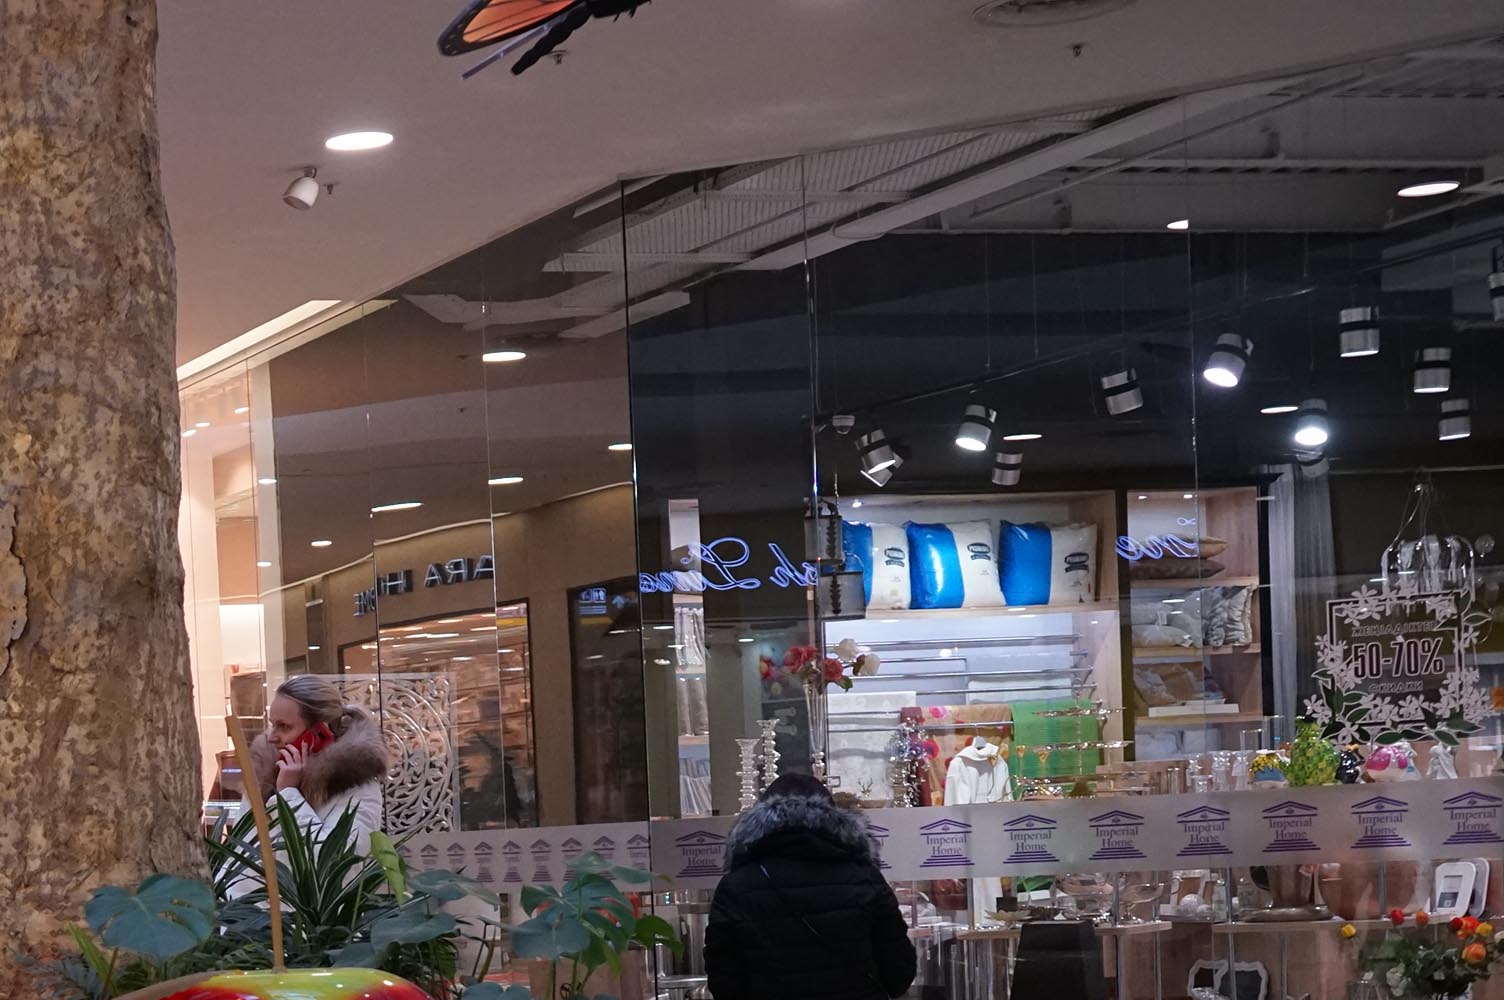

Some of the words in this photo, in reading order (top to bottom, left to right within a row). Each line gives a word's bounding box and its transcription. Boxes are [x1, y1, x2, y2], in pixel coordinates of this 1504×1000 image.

[1351, 637, 1446, 680] 50-70%
[1358, 814, 1403, 827] Imperial
[1449, 809, 1497, 823] Imperial
[1269, 818, 1313, 830] Imperial
[1457, 820, 1490, 832] Home
[1010, 830, 1052, 843] Imperial
[1096, 826, 1139, 839] Imperial
[1275, 829, 1307, 840] Home
[1364, 825, 1397, 836] Home
[926, 834, 967, 847] Imperial
[1016, 841, 1046, 852] Home
[1102, 837, 1133, 848] Home
[932, 845, 962, 856] Home
